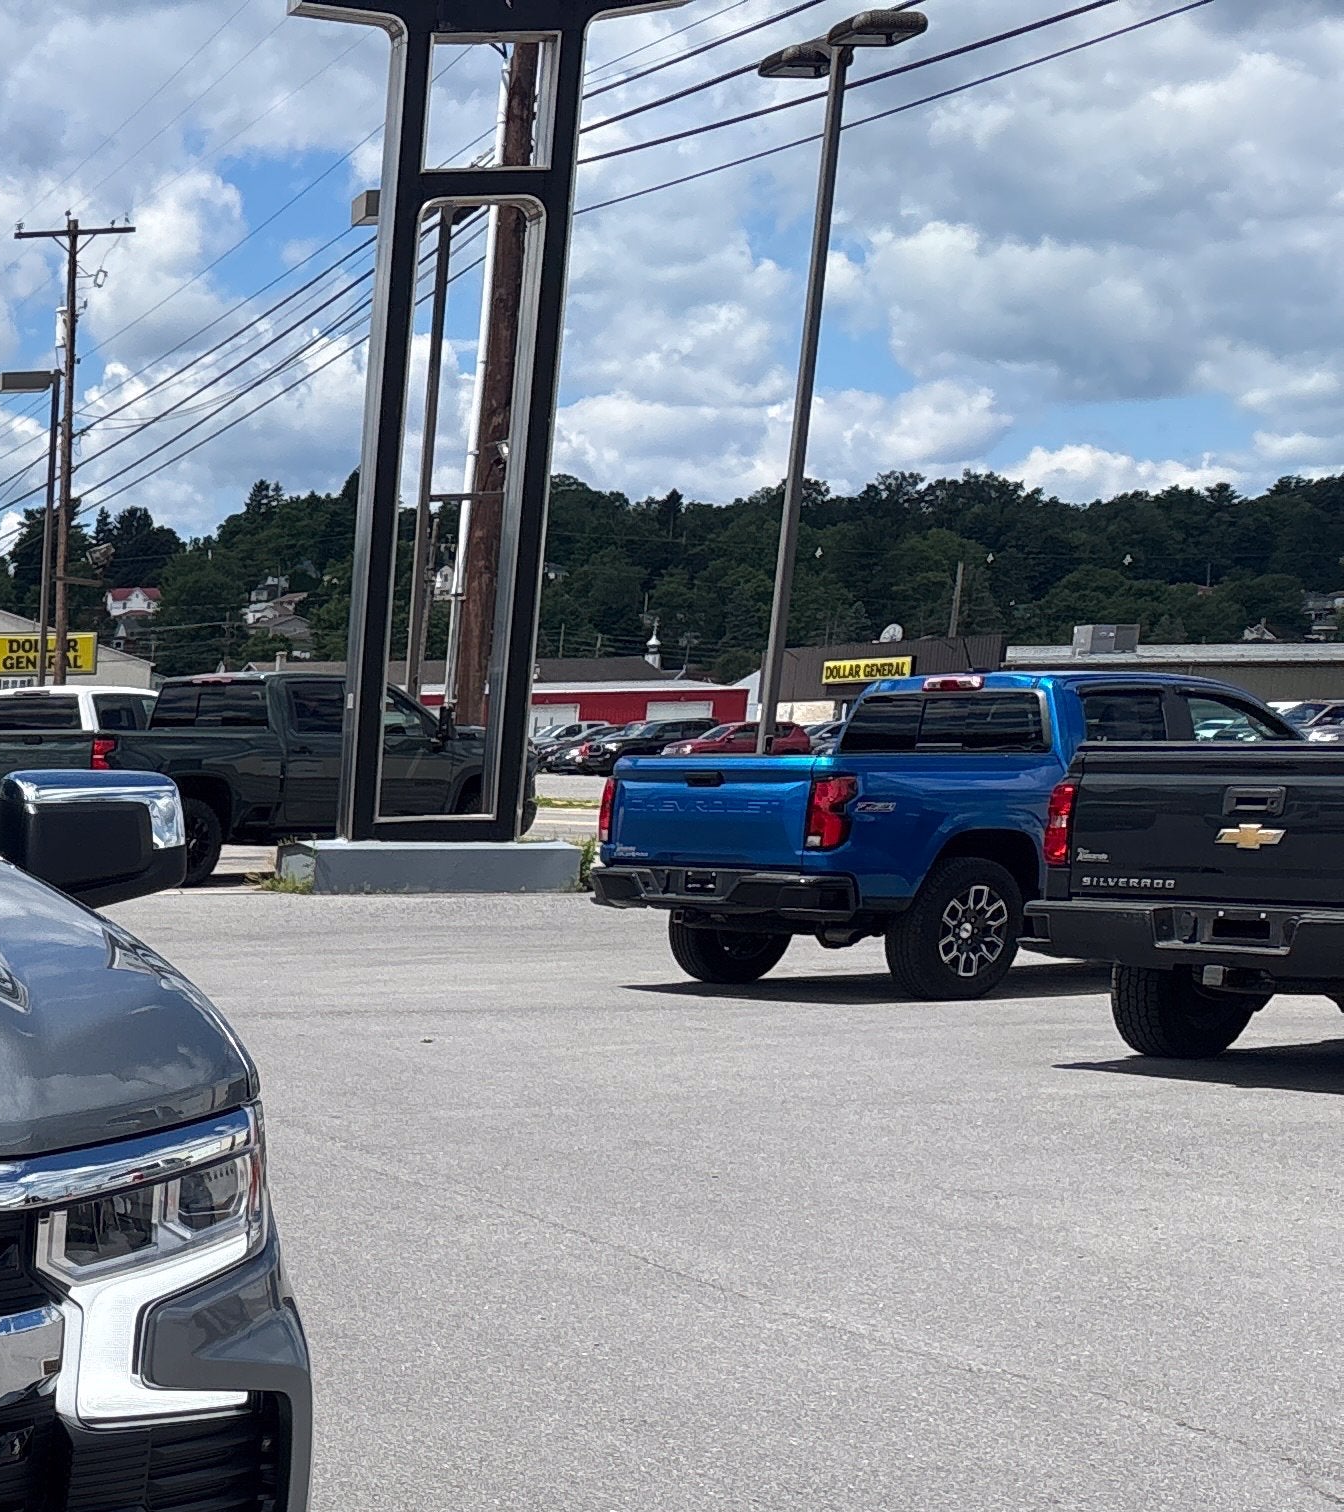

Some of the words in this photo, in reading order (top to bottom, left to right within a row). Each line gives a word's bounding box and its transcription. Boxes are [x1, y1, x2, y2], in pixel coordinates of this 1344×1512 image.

[8, 638, 79, 653] DOLLR
[2, 654, 83, 670] GENRL
[825, 664, 861, 680] DOLLAR
[863, 662, 906, 677] GENERAL
[1081, 876, 1176, 889] SILVERADO
